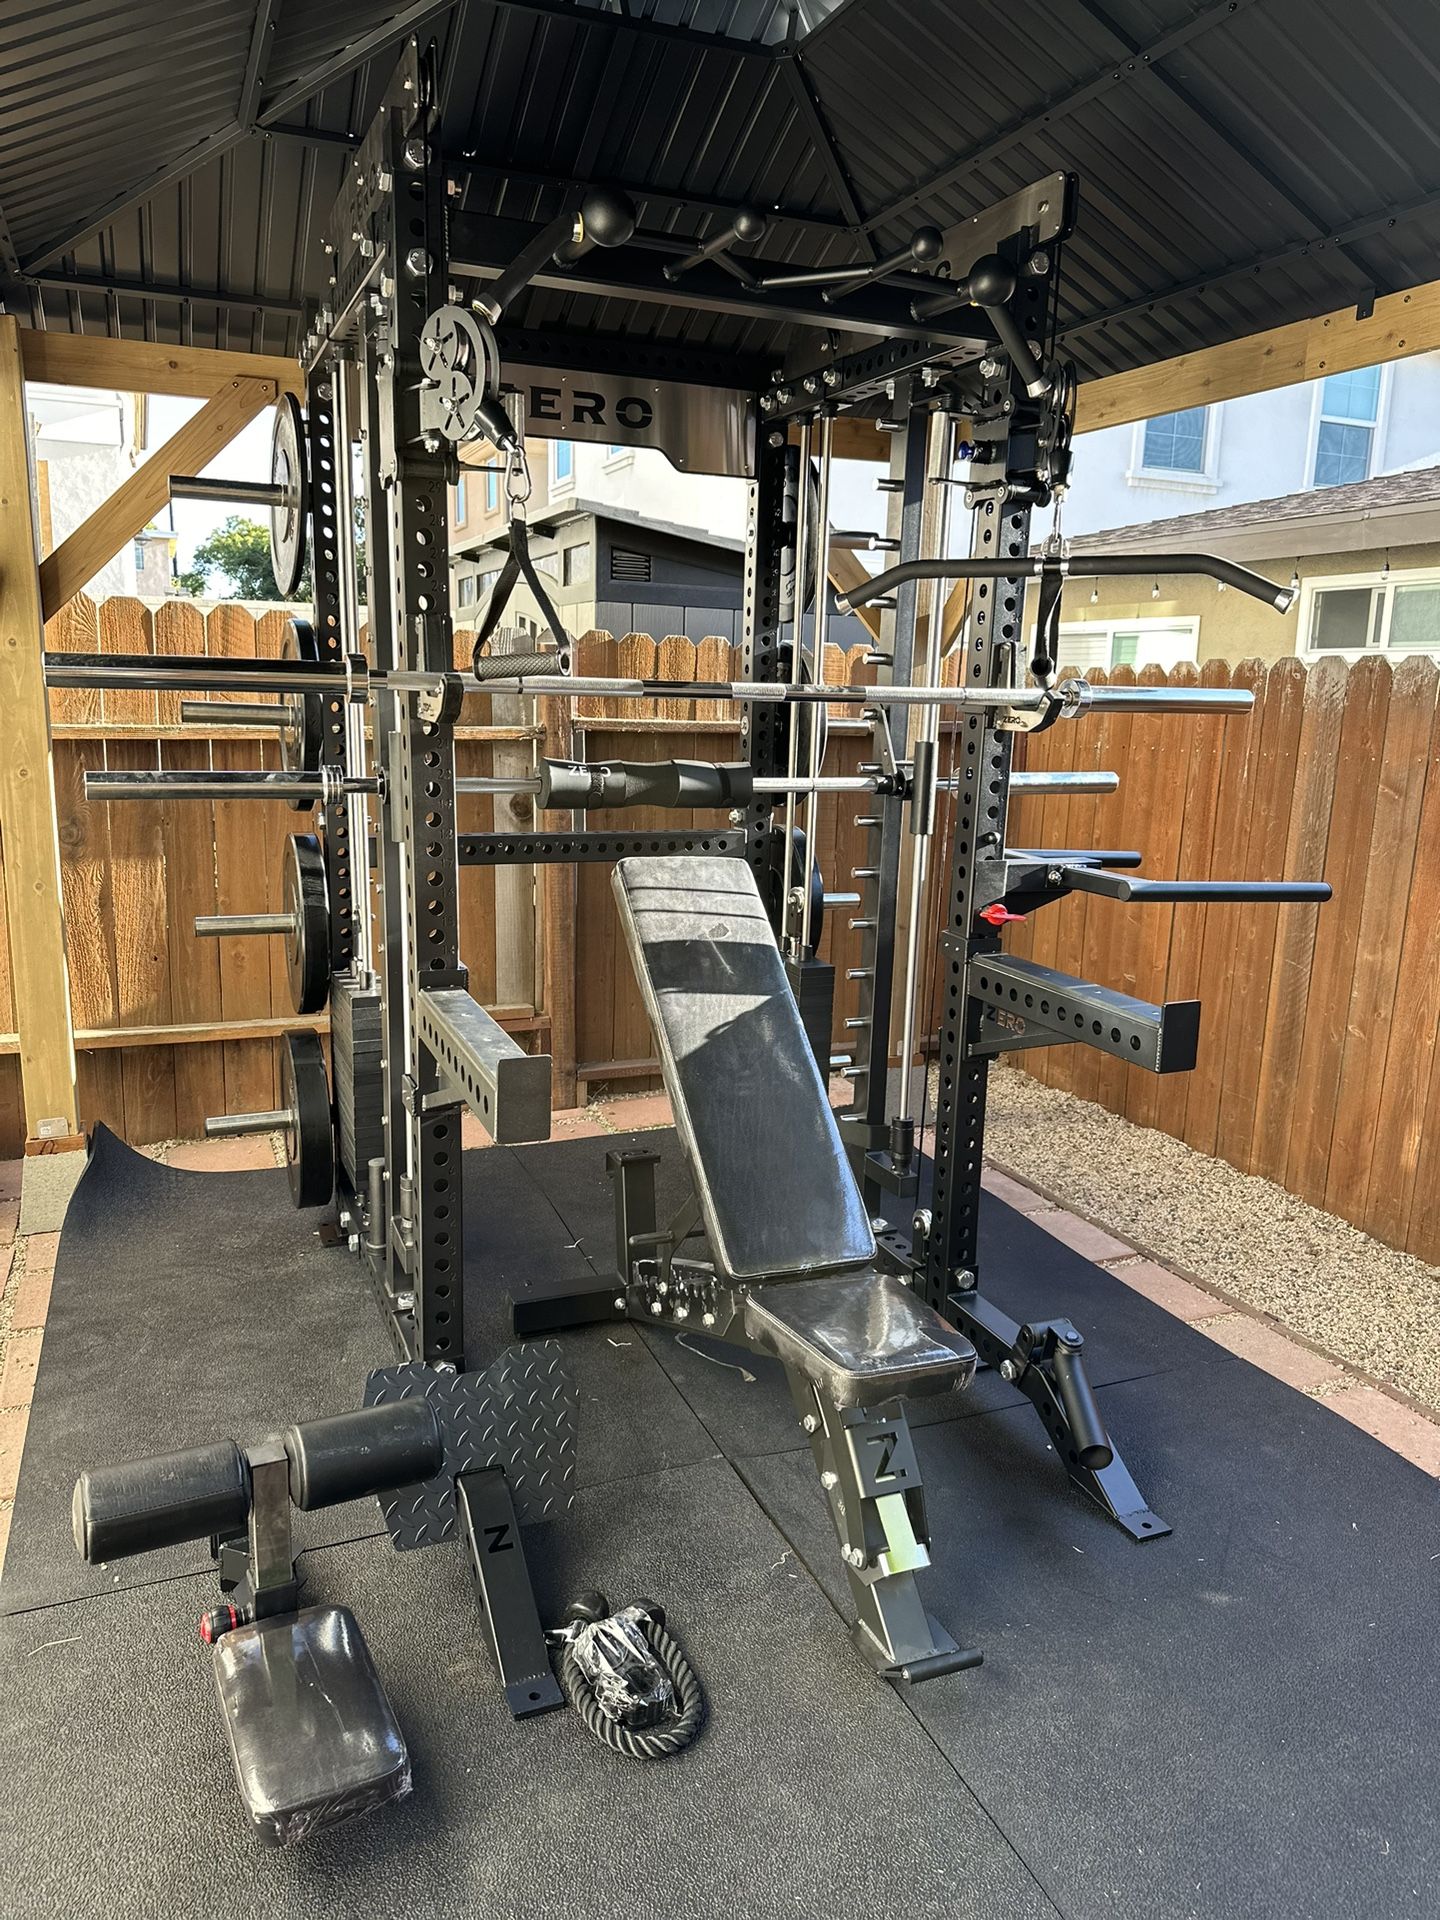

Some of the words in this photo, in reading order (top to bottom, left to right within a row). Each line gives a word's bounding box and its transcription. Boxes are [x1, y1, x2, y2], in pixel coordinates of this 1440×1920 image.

[499, 383, 653, 429] ERO
[1002, 716, 1021, 724] ZERO
[568, 765, 612, 778] ZEO
[986, 1004, 1026, 1036] ZERO
